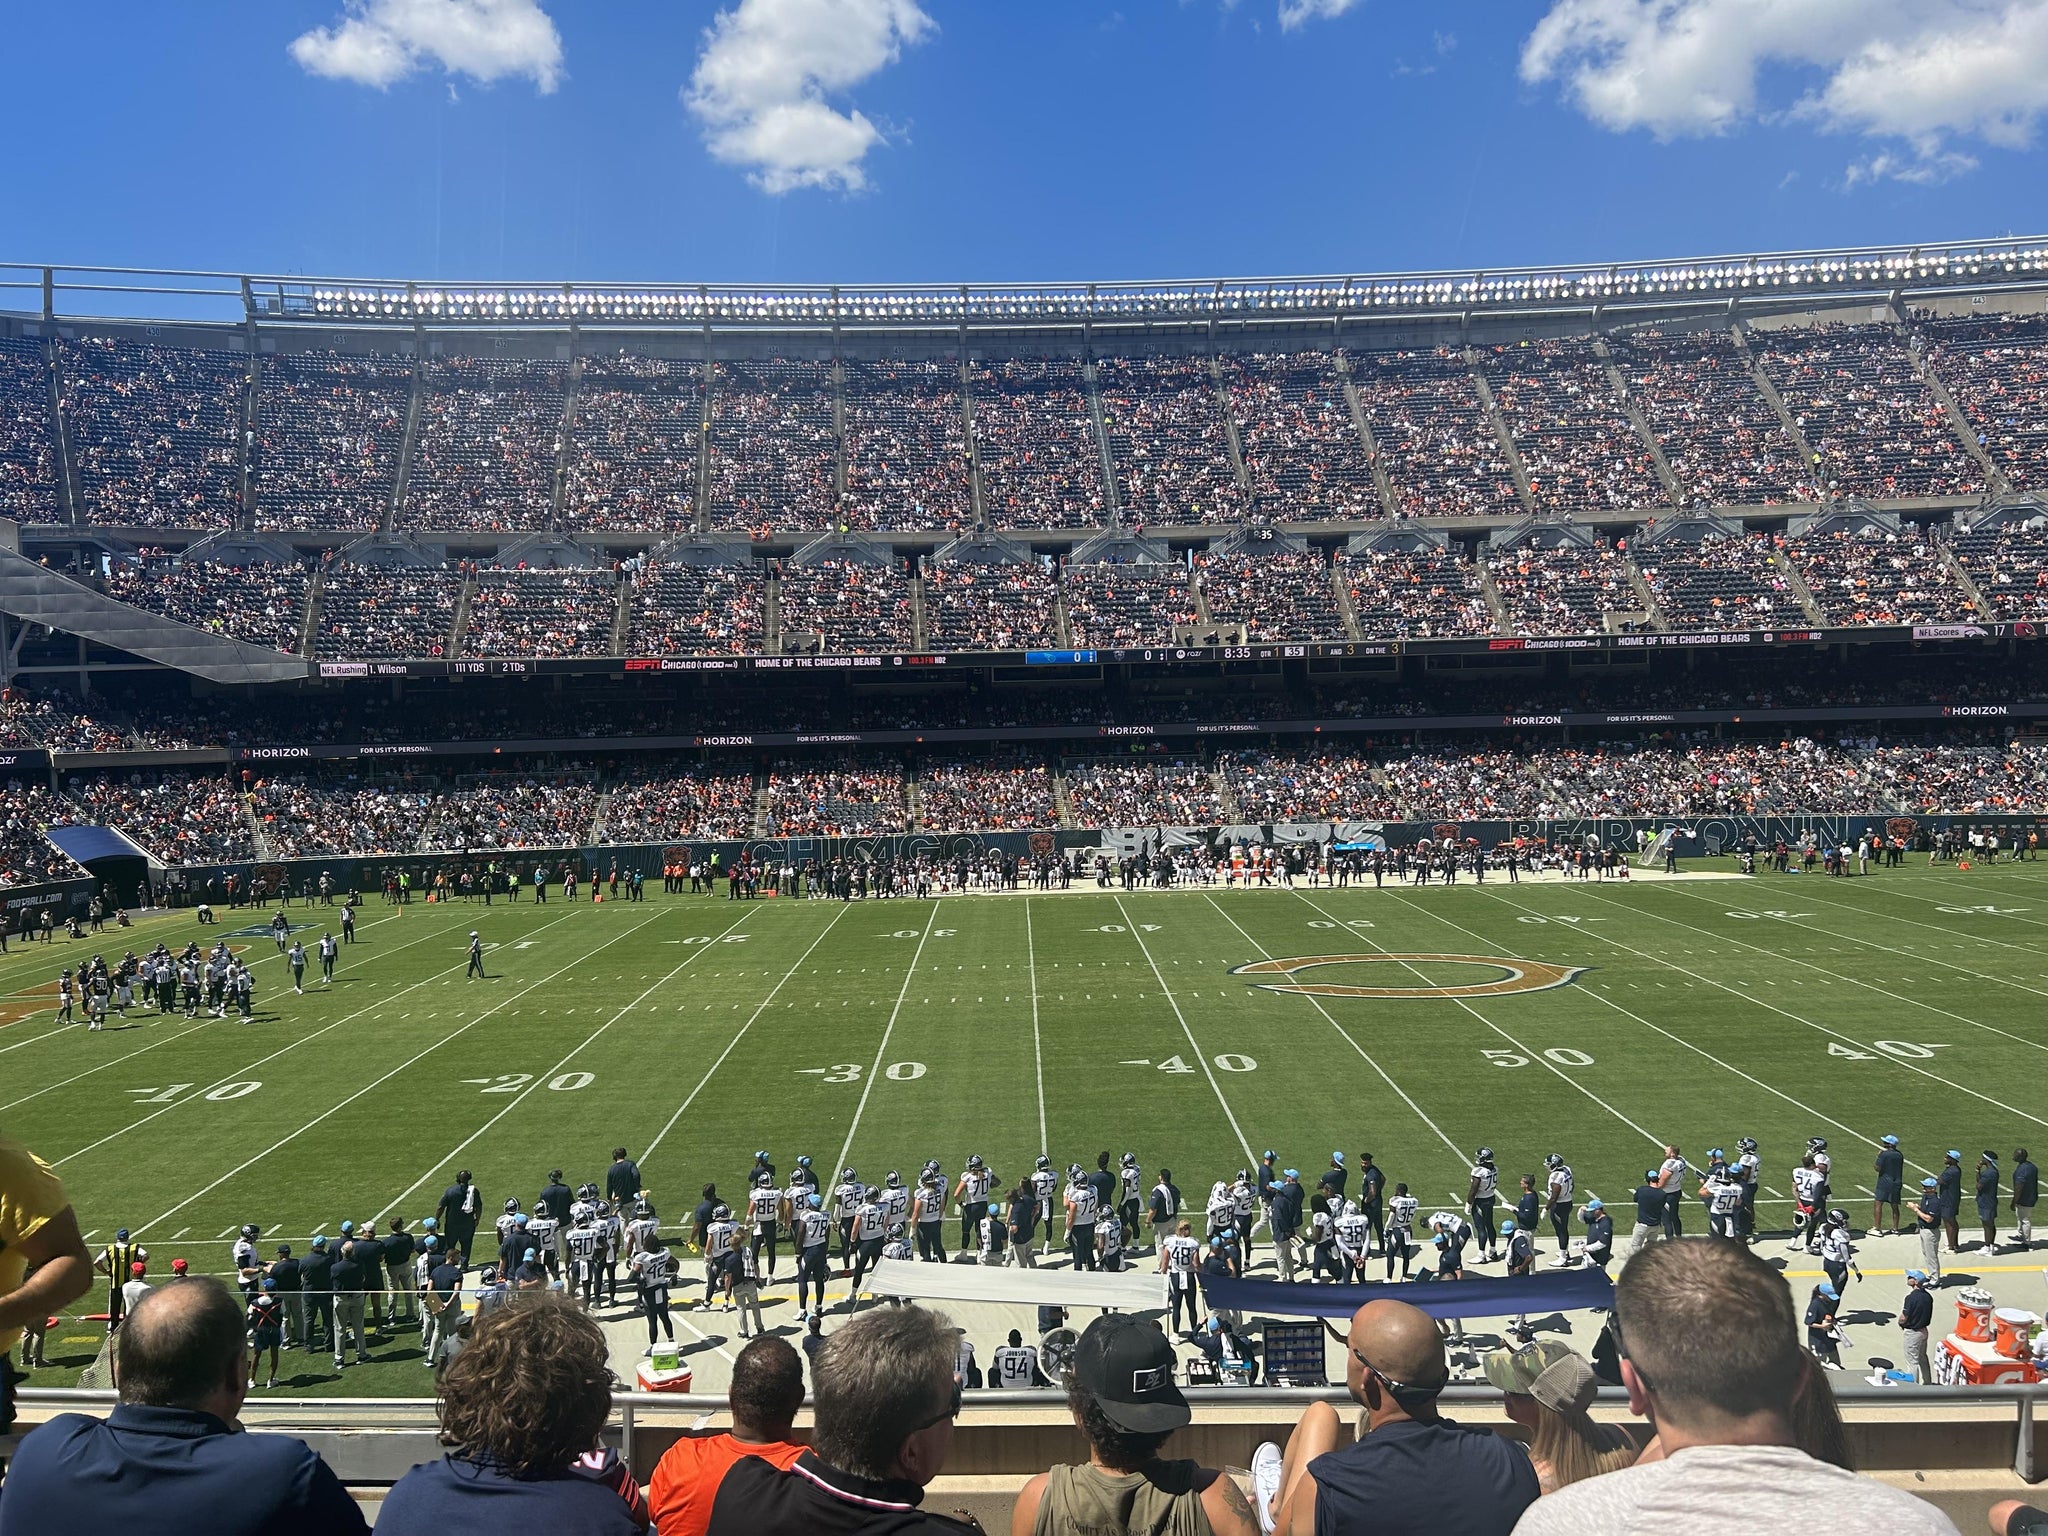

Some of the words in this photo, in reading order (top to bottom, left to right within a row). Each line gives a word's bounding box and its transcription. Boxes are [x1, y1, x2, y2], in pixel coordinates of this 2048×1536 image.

[1972, 296, 1985, 305] 443
[146, 327, 160, 336] 430
[334, 335, 347, 344] 431
[1809, 632, 1822, 640] HD2
[1933, 628, 1959, 636] Scores
[1994, 625, 2006, 636] 17
[1489, 640, 1524, 650] ESPN
[1618, 637, 1644, 646] HOME
[1646, 637, 1657, 645] OF
[1660, 636, 1677, 645] THE
[1679, 635, 1718, 644] CHICAGO
[1720, 633, 1750, 643] BEARS
[1074, 652, 1081, 662] 0
[1144, 650, 1152, 661] 0
[1224, 647, 1250, 658] 8:35
[1274, 647, 1279, 656] 1
[1288, 647, 1300, 655] 35
[1317, 645, 1322, 655] 1
[1347, 644, 1354, 654] 3
[1391, 642, 1399, 653] 3
[455, 663, 466, 672] 111
[468, 663, 484, 672] YDS
[502, 663, 508, 672] 2
[509, 662, 525, 671] TDs
[624, 660, 661, 670] ESPN
[755, 658, 781, 667] HOME
[783, 658, 794, 667] OF
[796, 657, 812, 667] THE
[814, 657, 851, 667] CHICAGO
[853, 656, 881, 666] BEARS
[925, 656, 934, 664] FM
[934, 656, 946, 664] HD2
[337, 666, 366, 675] Rushing
[369, 665, 376, 674] 1.
[378, 664, 406, 674] Wilson
[1508, 817, 1633, 853] BEAR
[742, 834, 985, 868] CHICAGO
[7, 893, 63, 910] FOOTBALL.COM
[1307, 920, 1376, 929] 50
[682, 934, 752, 944] 20
[893, 929, 958, 938] 30
[96, 980, 107, 991] 90
[1480, 1048, 1595, 1068] 50
[1827, 1040, 1936, 1061] 40
[823, 1061, 928, 1083] 30
[1157, 1054, 1258, 1073] 40
[480, 1072, 596, 1093] 20
[134, 1081, 263, 1103] 10
[972, 1178, 989, 1196] 70
[1039, 1178, 1057, 1195] 23
[1485, 1174, 1498, 1191] 79
[1796, 1175, 1813, 1195] 24
[757, 1197, 775, 1214] 86
[845, 1191, 863, 1210] 25
[890, 1196, 906, 1215] 62
[927, 1194, 941, 1213] 68
[1081, 1195, 1096, 1216] 72
[1716, 1195, 1738, 1210] 50
[867, 1211, 885, 1231] 64
[1397, 1206, 1415, 1223] 36
[811, 1219, 828, 1239] 78
[1343, 1225, 1363, 1243] 38
[574, 1237, 593, 1256] 80
[719, 1229, 732, 1249] 12
[1172, 1246, 1190, 1265] 48
[1005, 1356, 1028, 1379] 94
